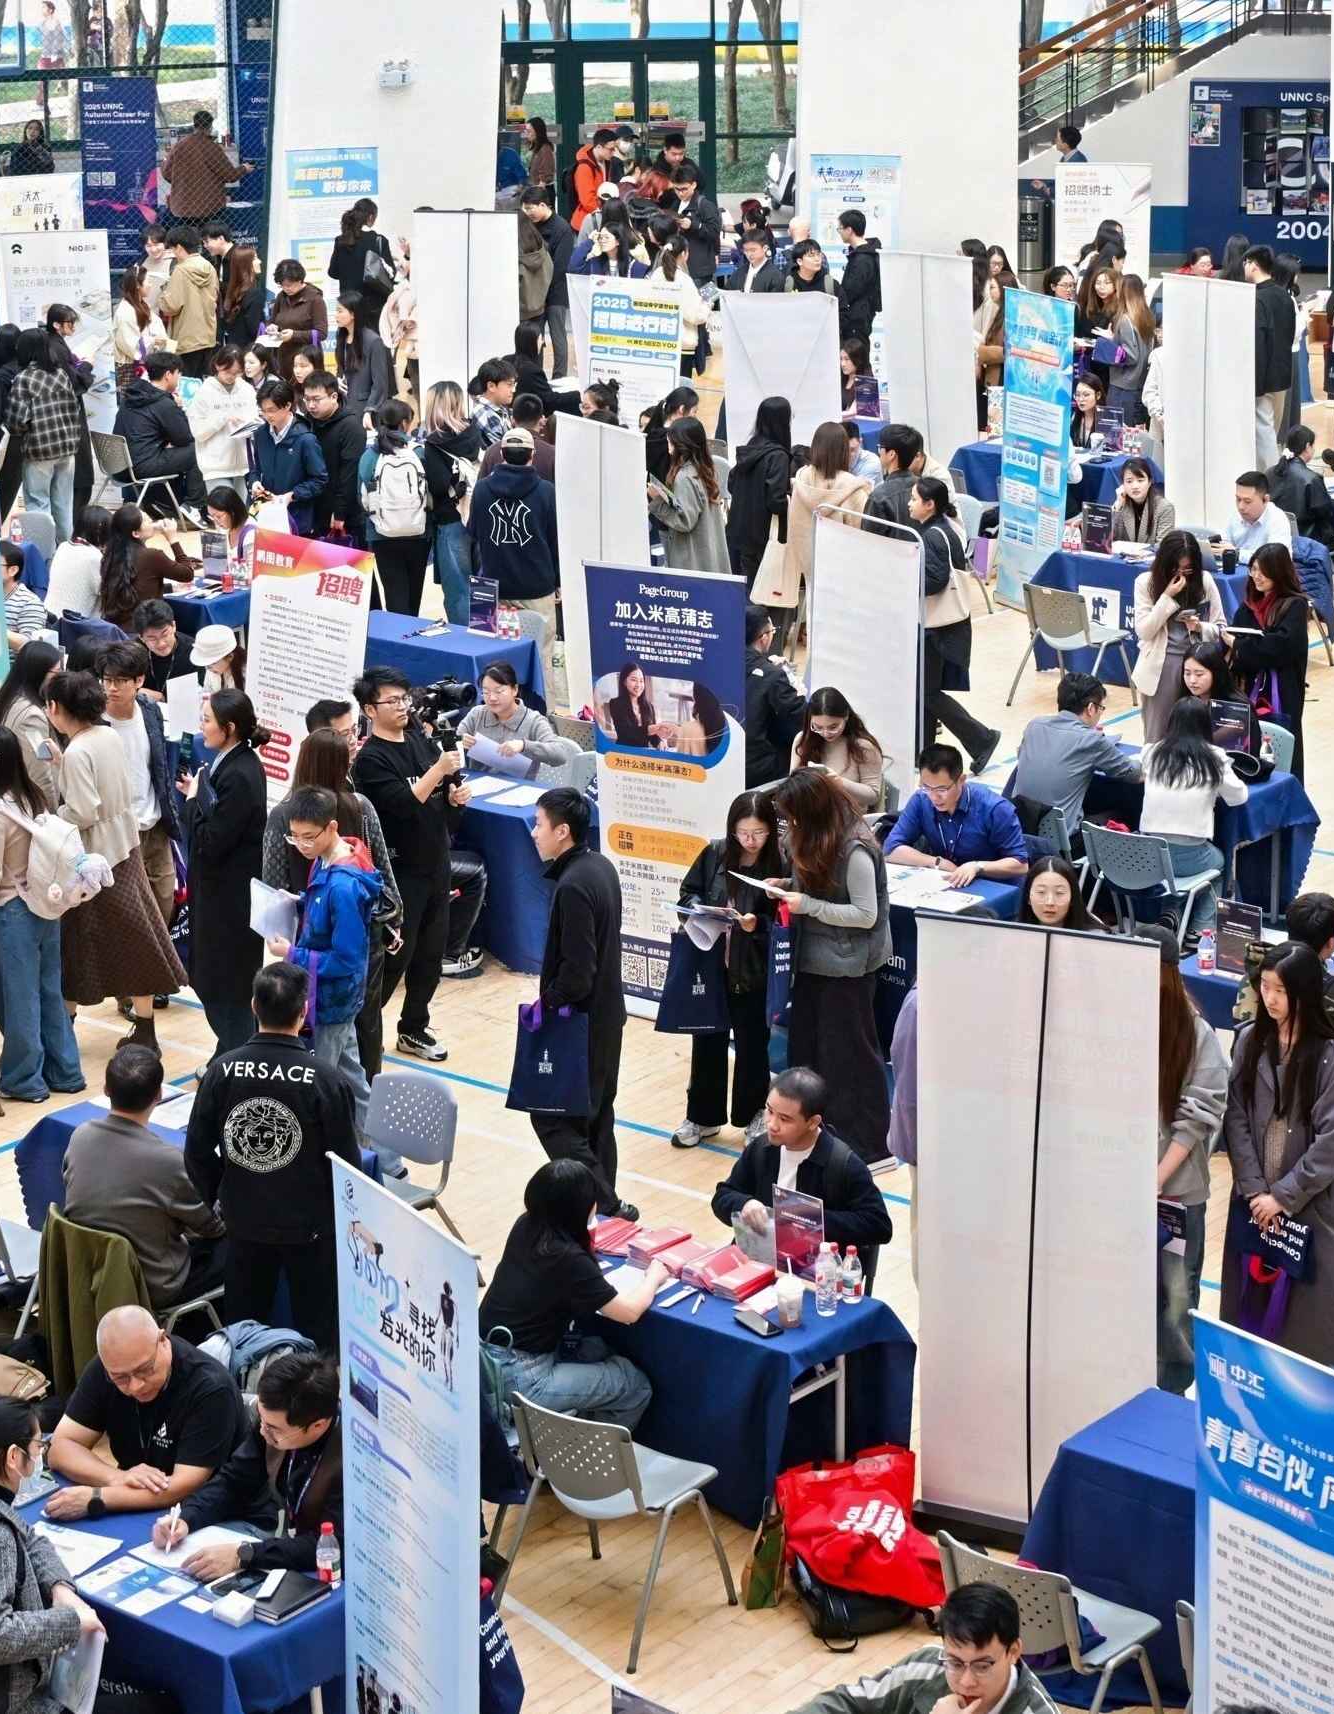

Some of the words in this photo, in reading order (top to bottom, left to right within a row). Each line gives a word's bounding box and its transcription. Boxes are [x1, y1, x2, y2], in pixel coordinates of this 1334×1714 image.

[1280, 92, 1313, 102] UNNC
[593, 294, 629, 310] 2025
[662, 341, 677, 349] YOU
[316, 571, 365, 606] 招聘
[639, 583, 689, 602] PageGroup
[615, 600, 714, 629] 加入米高蒲志
[222, 1060, 316, 1085] VERSACE
[379, 1310, 436, 1374] 发光的你
[1230, 1364, 1266, 1390] 中汇
[1205, 1416, 1315, 1498] 青春合伙
[484, 1632, 499, 1652] and
